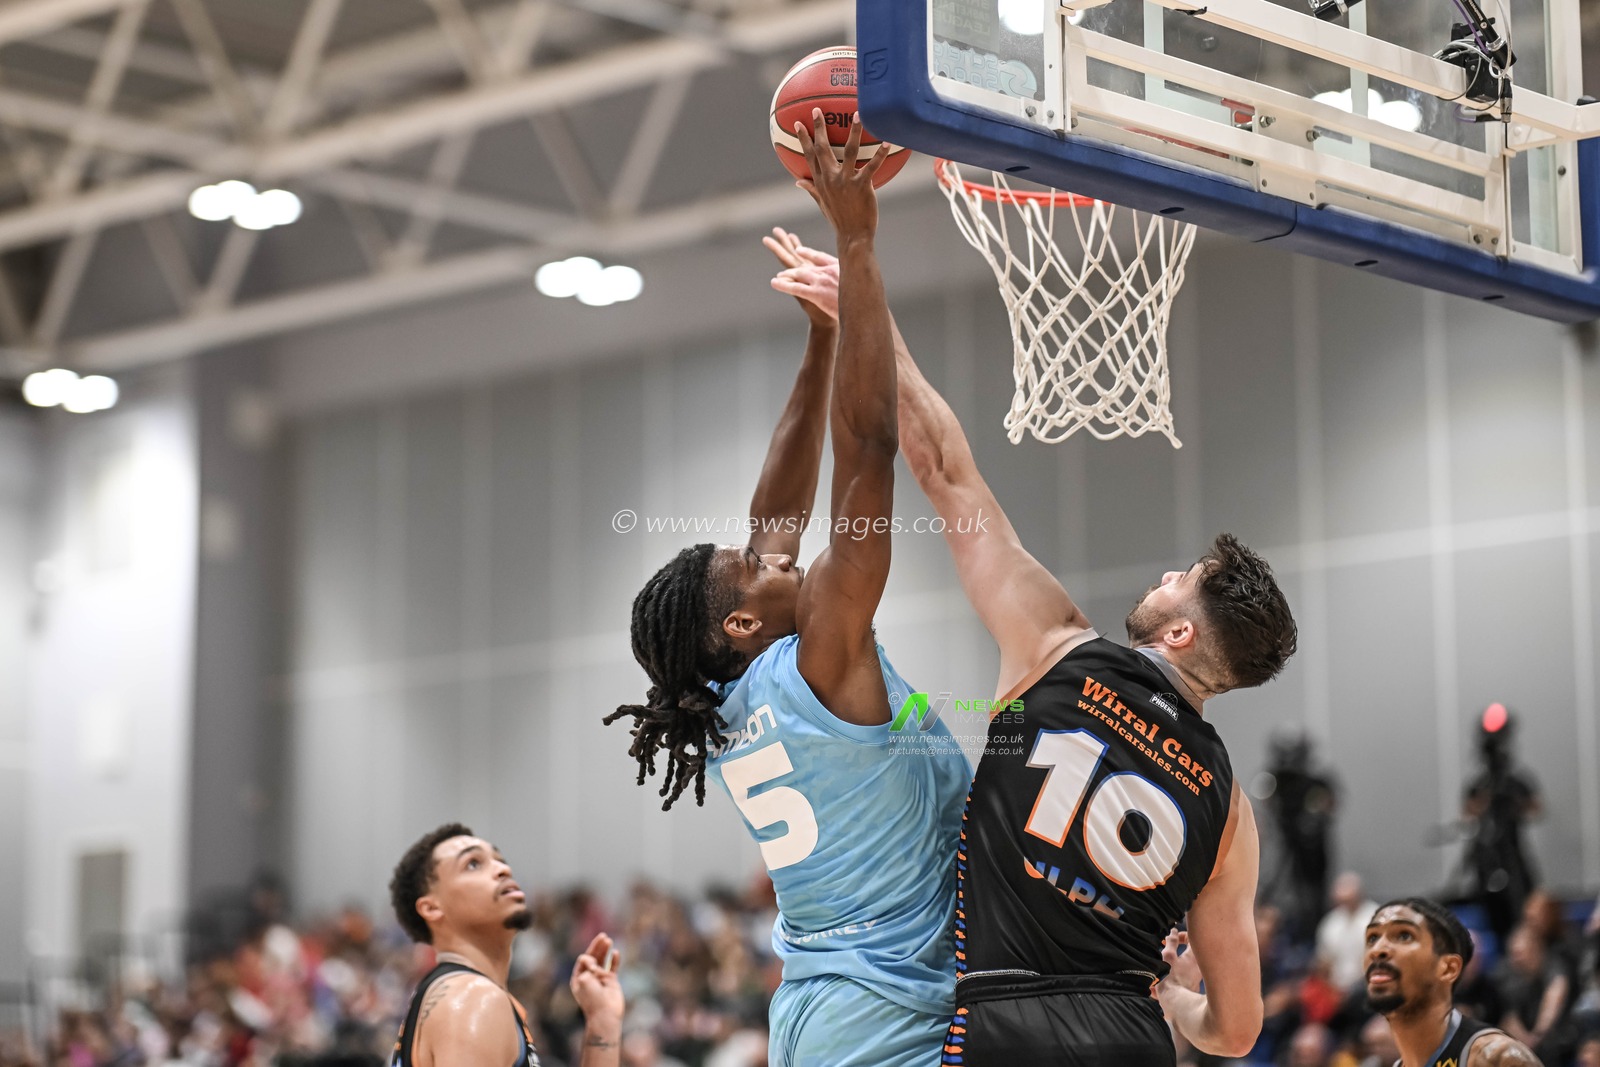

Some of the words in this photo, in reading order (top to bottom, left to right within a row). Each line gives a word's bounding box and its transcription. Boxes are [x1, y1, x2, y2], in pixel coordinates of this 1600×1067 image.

[1077, 700, 1201, 796] wirralcarsales.com
[1080, 676, 1160, 742] Wirral
[1162, 738, 1214, 787] Cars
[1150, 695, 1178, 720] PHOENIX
[720, 740, 819, 872] 5
[1023, 727, 1188, 892] 10
